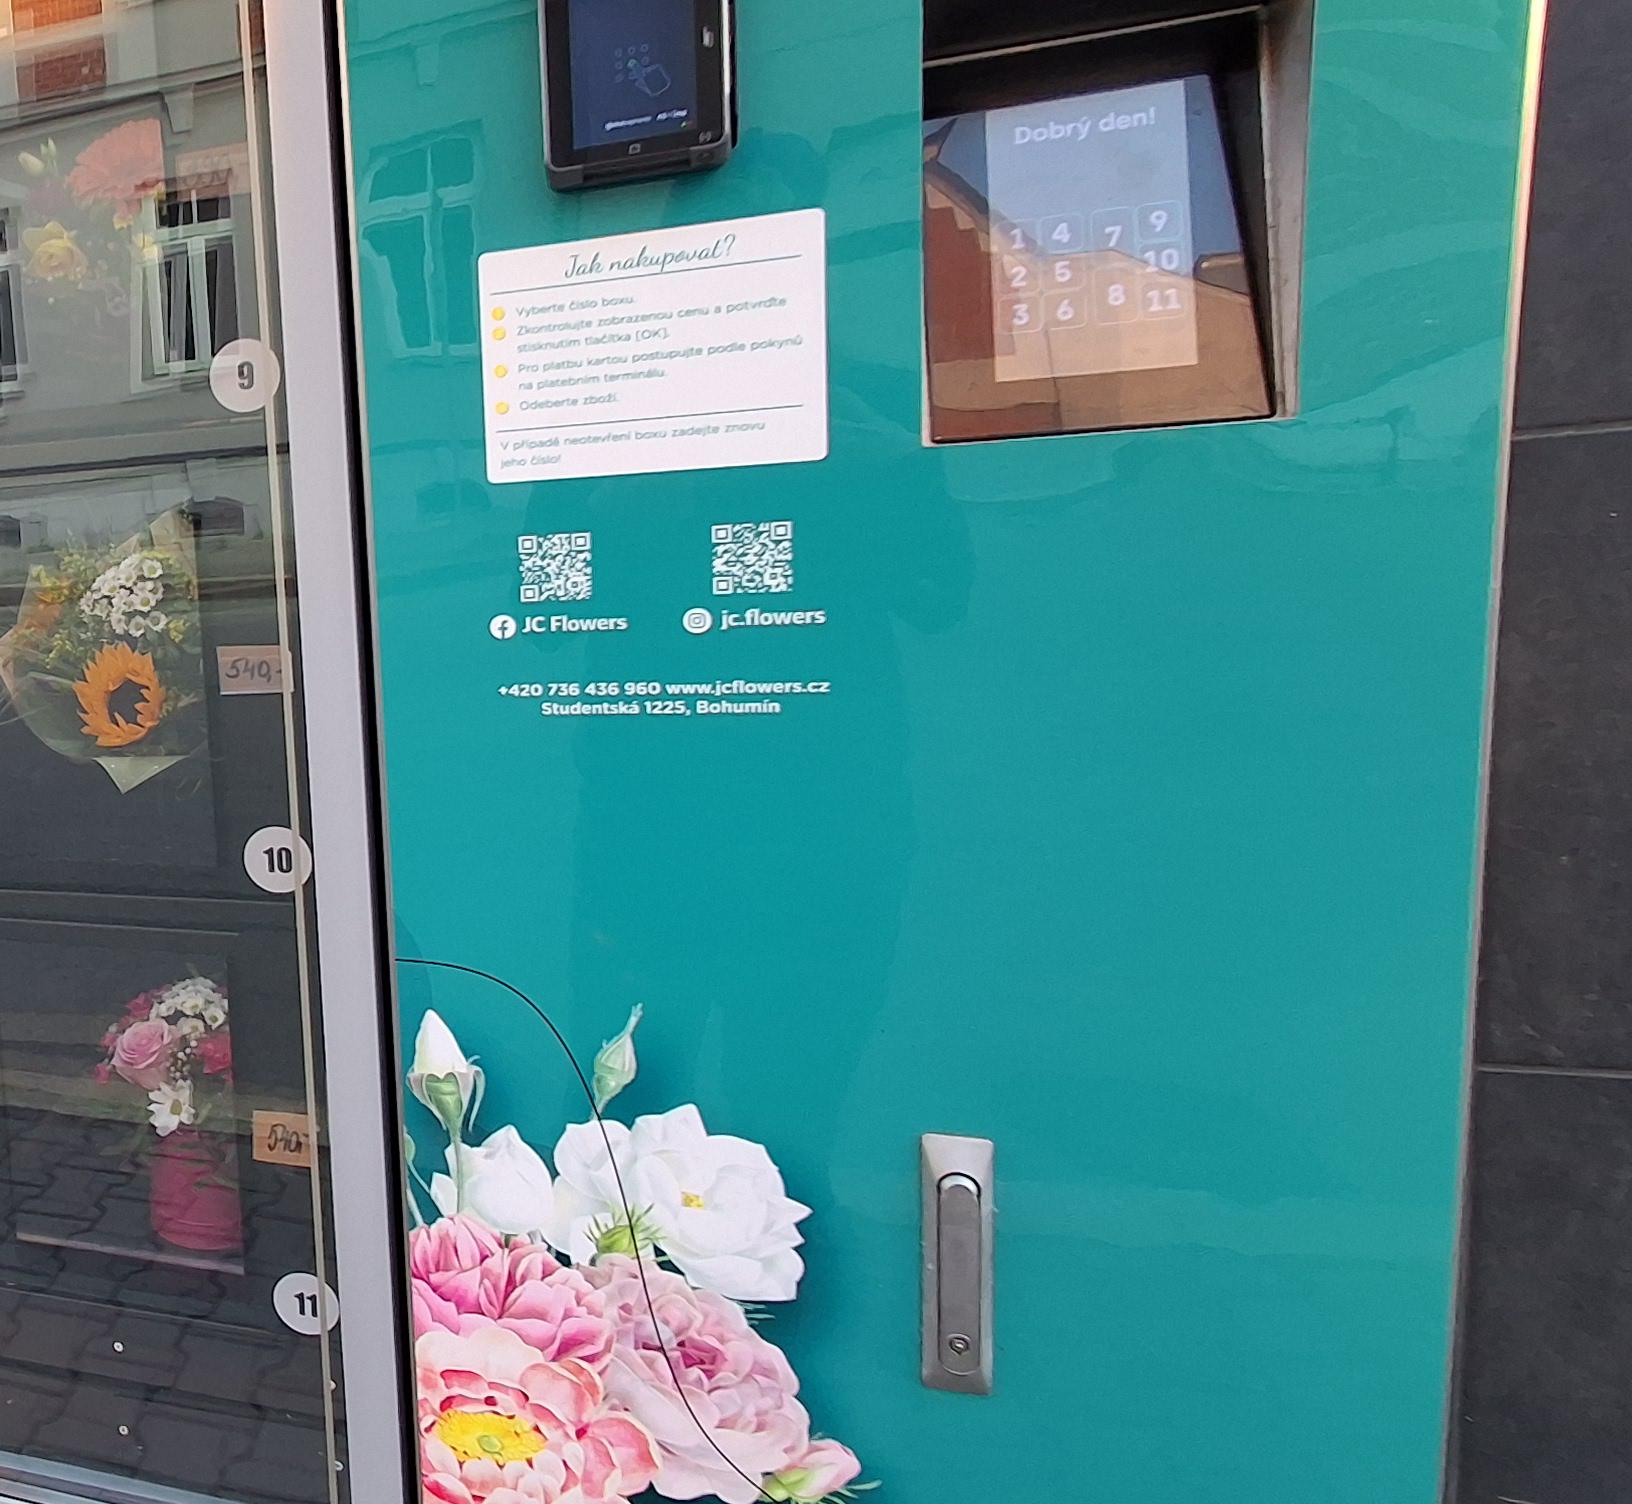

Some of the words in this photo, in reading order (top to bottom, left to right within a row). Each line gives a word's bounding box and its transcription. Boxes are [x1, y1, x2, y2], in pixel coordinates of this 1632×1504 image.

[1014, 116, 1091, 145] Dobrý
[1098, 106, 1157, 133] den!
[1149, 209, 1168, 232] 9
[1010, 228, 1025, 249] 1
[1051, 223, 1072, 243] 4
[1104, 226, 1123, 247] 7
[564, 254, 604, 279] Jak
[608, 233, 737, 273] nakupovat?
[1143, 249, 1180, 272] 10
[1011, 266, 1028, 287] 2
[1055, 261, 1072, 282] 5
[1108, 284, 1125, 306] 8
[1146, 289, 1182, 311] 11
[515, 303, 566, 318] Vyberte
[568, 299, 598, 311] číslo
[1012, 304, 1030, 325] 3
[1056, 299, 1074, 321] 6
[517, 320, 593, 336] Zkontrolujte
[598, 312, 673, 327] zobrazenou
[677, 307, 710, 318] cenu
[713, 305, 722, 314] a
[518, 363, 539, 373] Pro
[542, 359, 583, 373] platbu
[586, 355, 628, 367] kartou
[631, 346, 703, 363] postupujte
[707, 341, 747, 356] podle
[237, 361, 255, 390] 9
[518, 382, 533, 390] na
[519, 398, 579, 411] Odeberte
[500, 441, 510, 451] V
[635, 430, 667, 441] boxu
[671, 424, 721, 438] zadejte
[724, 421, 767, 433] znovu
[500, 459, 527, 469] jeho
[521, 616, 546, 634] JC
[550, 615, 629, 634] Flowers
[719, 608, 827, 631] jc.flowers
[498, 683, 543, 698] +420
[547, 683, 580, 697] 736
[584, 682, 620, 696] 436
[624, 681, 663, 696] 960
[665, 680, 832, 697] www.jcflowers.cz
[541, 700, 640, 717] Studentská
[644, 700, 692, 717] 1225,
[695, 699, 782, 715] Bohumín
[263, 847, 294, 873] 10
[294, 1292, 319, 1318] 11
